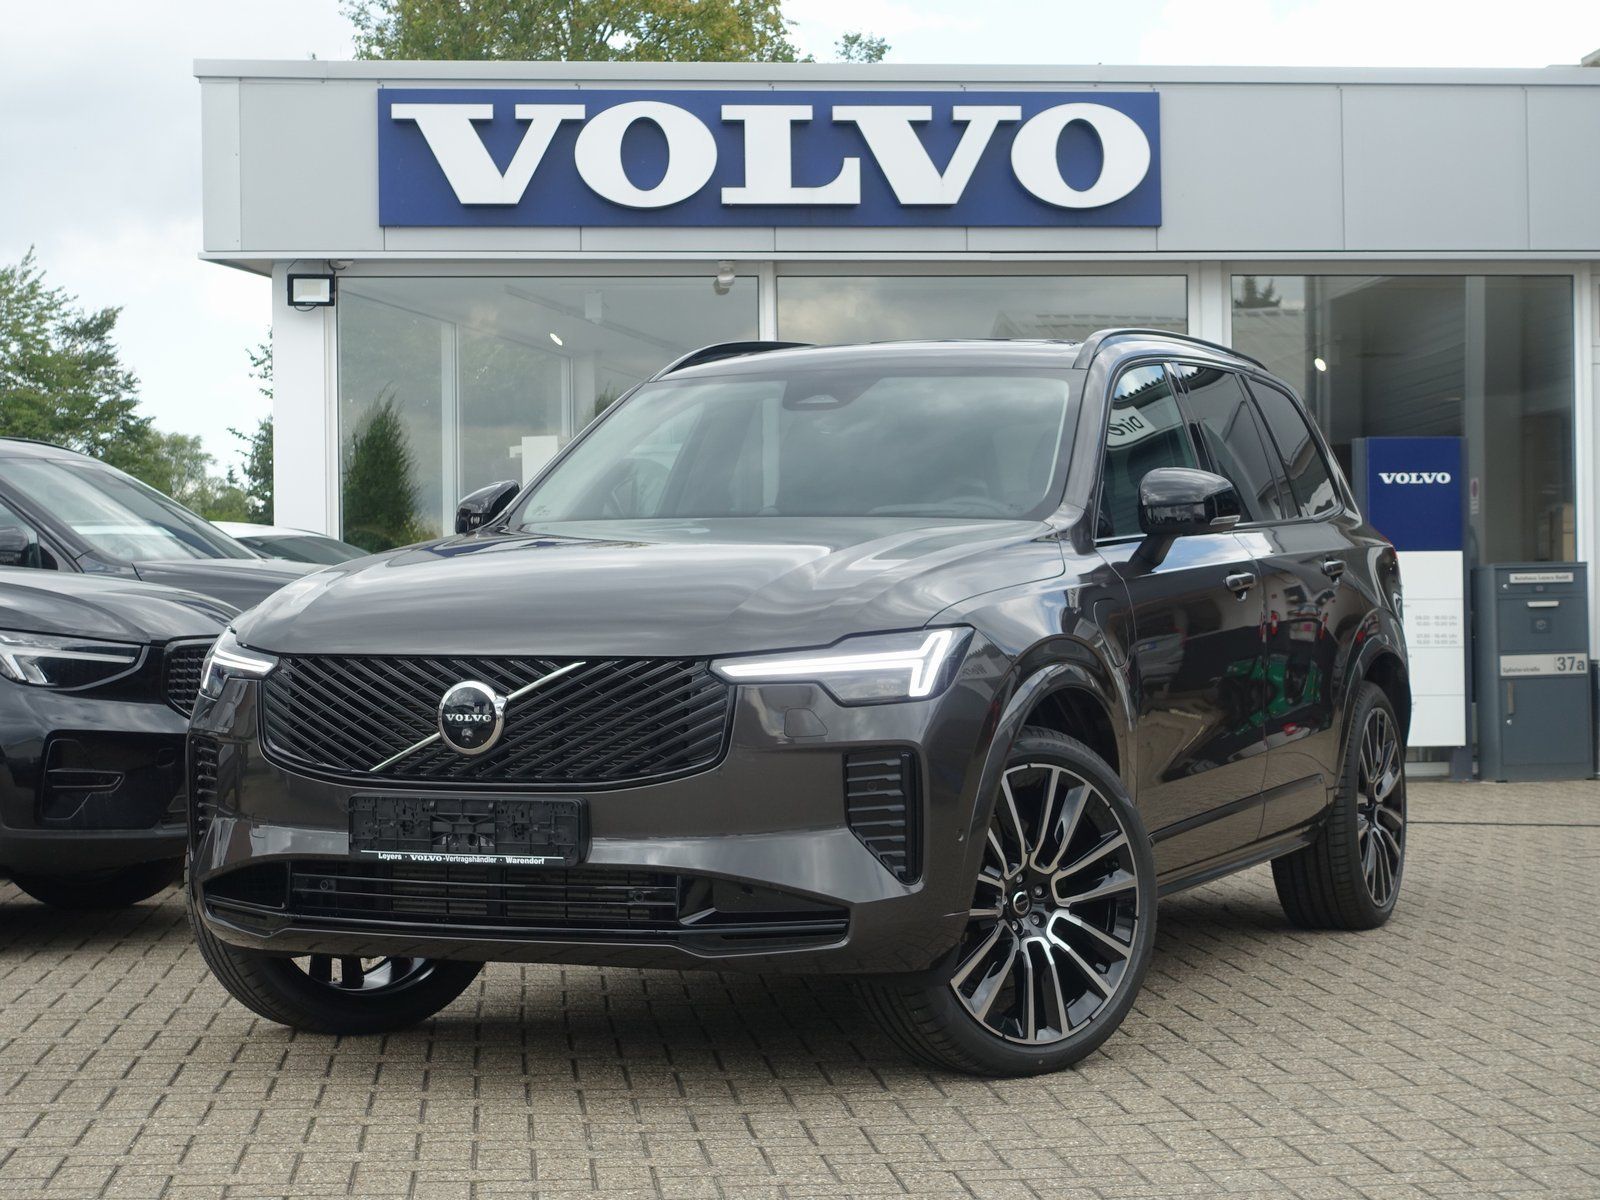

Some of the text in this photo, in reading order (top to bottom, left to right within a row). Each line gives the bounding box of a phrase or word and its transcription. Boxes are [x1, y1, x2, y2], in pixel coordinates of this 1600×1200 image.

[391, 101, 1151, 208] VOLVO
[1379, 472, 1451, 484] VOLVO
[1557, 656, 1585, 672] 37a
[445, 713, 492, 722] VOLVO
[505, 856, 545, 864] Warendorf
